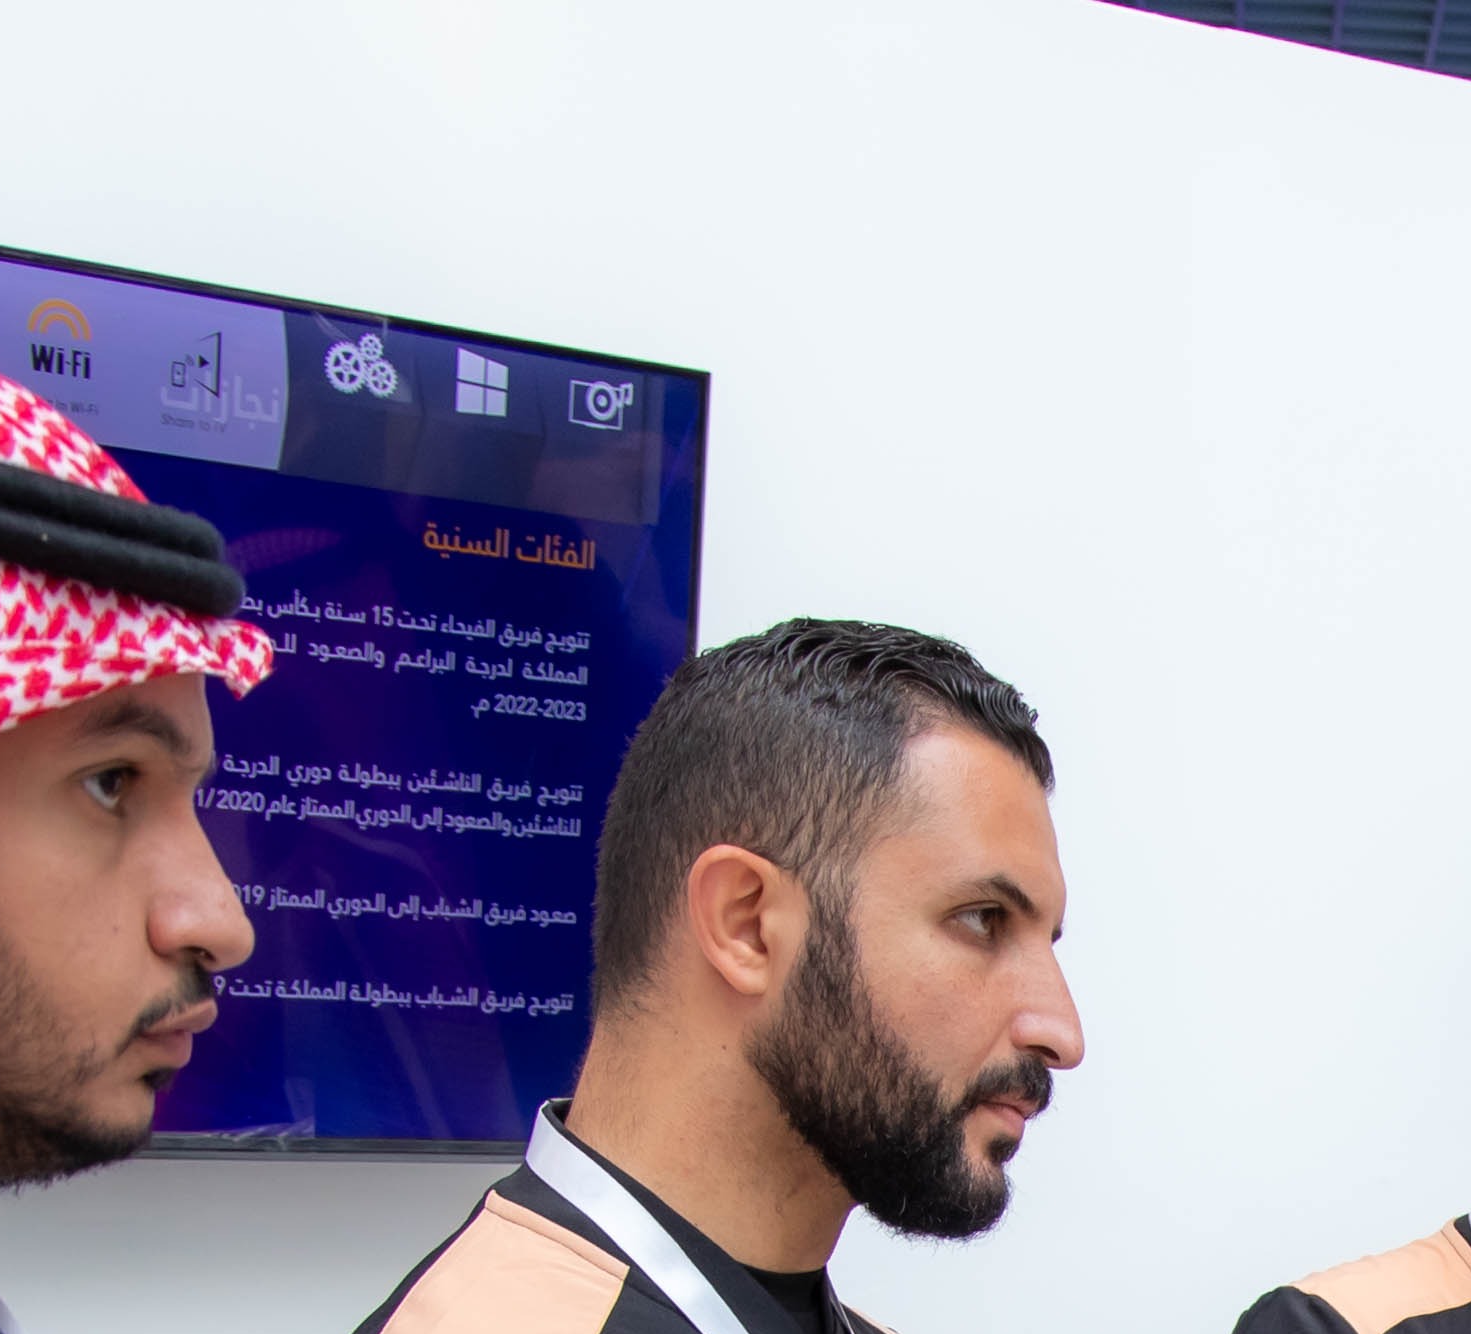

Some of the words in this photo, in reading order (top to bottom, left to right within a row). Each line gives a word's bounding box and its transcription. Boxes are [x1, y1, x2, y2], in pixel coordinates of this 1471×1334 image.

[30, 343, 91, 379] Wi-Fi
[160, 369, 280, 431] نجازات
[423, 522, 509, 560] السنية
[516, 534, 596, 570] الفئات
[324, 601, 366, 624] سنة
[371, 605, 395, 627] 15
[396, 611, 438, 632] تحت
[440, 614, 496, 641] الفيحاء
[498, 623, 543, 648] فريق
[308, 641, 385, 668] والصعود
[544, 631, 591, 654] تتويج
[394, 649, 457, 674] البراعم
[465, 656, 513, 681] لدرجة
[522, 661, 588, 686] المملكة
[222, 753, 281, 779] الدرجة
[286, 764, 332, 787] دوري
[407, 768, 482, 794] الناشئين
[486, 778, 532, 802] فريق
[265, 794, 297, 821] عام
[537, 784, 584, 807] تتويج
[297, 796, 356, 821] الممتاز
[355, 803, 411, 830] الدوري
[411, 806, 443, 833] إلى
[444, 811, 512, 837] والصعود
[512, 814, 582, 838] للناشئين
[267, 886, 325, 911] الممتاز
[327, 893, 386, 919] الدوري
[387, 895, 420, 921] إلى
[421, 896, 483, 922] الشباب
[484, 900, 527, 927] فريق
[529, 908, 577, 928] صعود
[227, 977, 273, 998] تحت
[275, 979, 347, 1001] المملكة
[415, 985, 478, 1010] الشباب
[481, 989, 526, 1014] فريق
[528, 992, 574, 1016] تتويج
